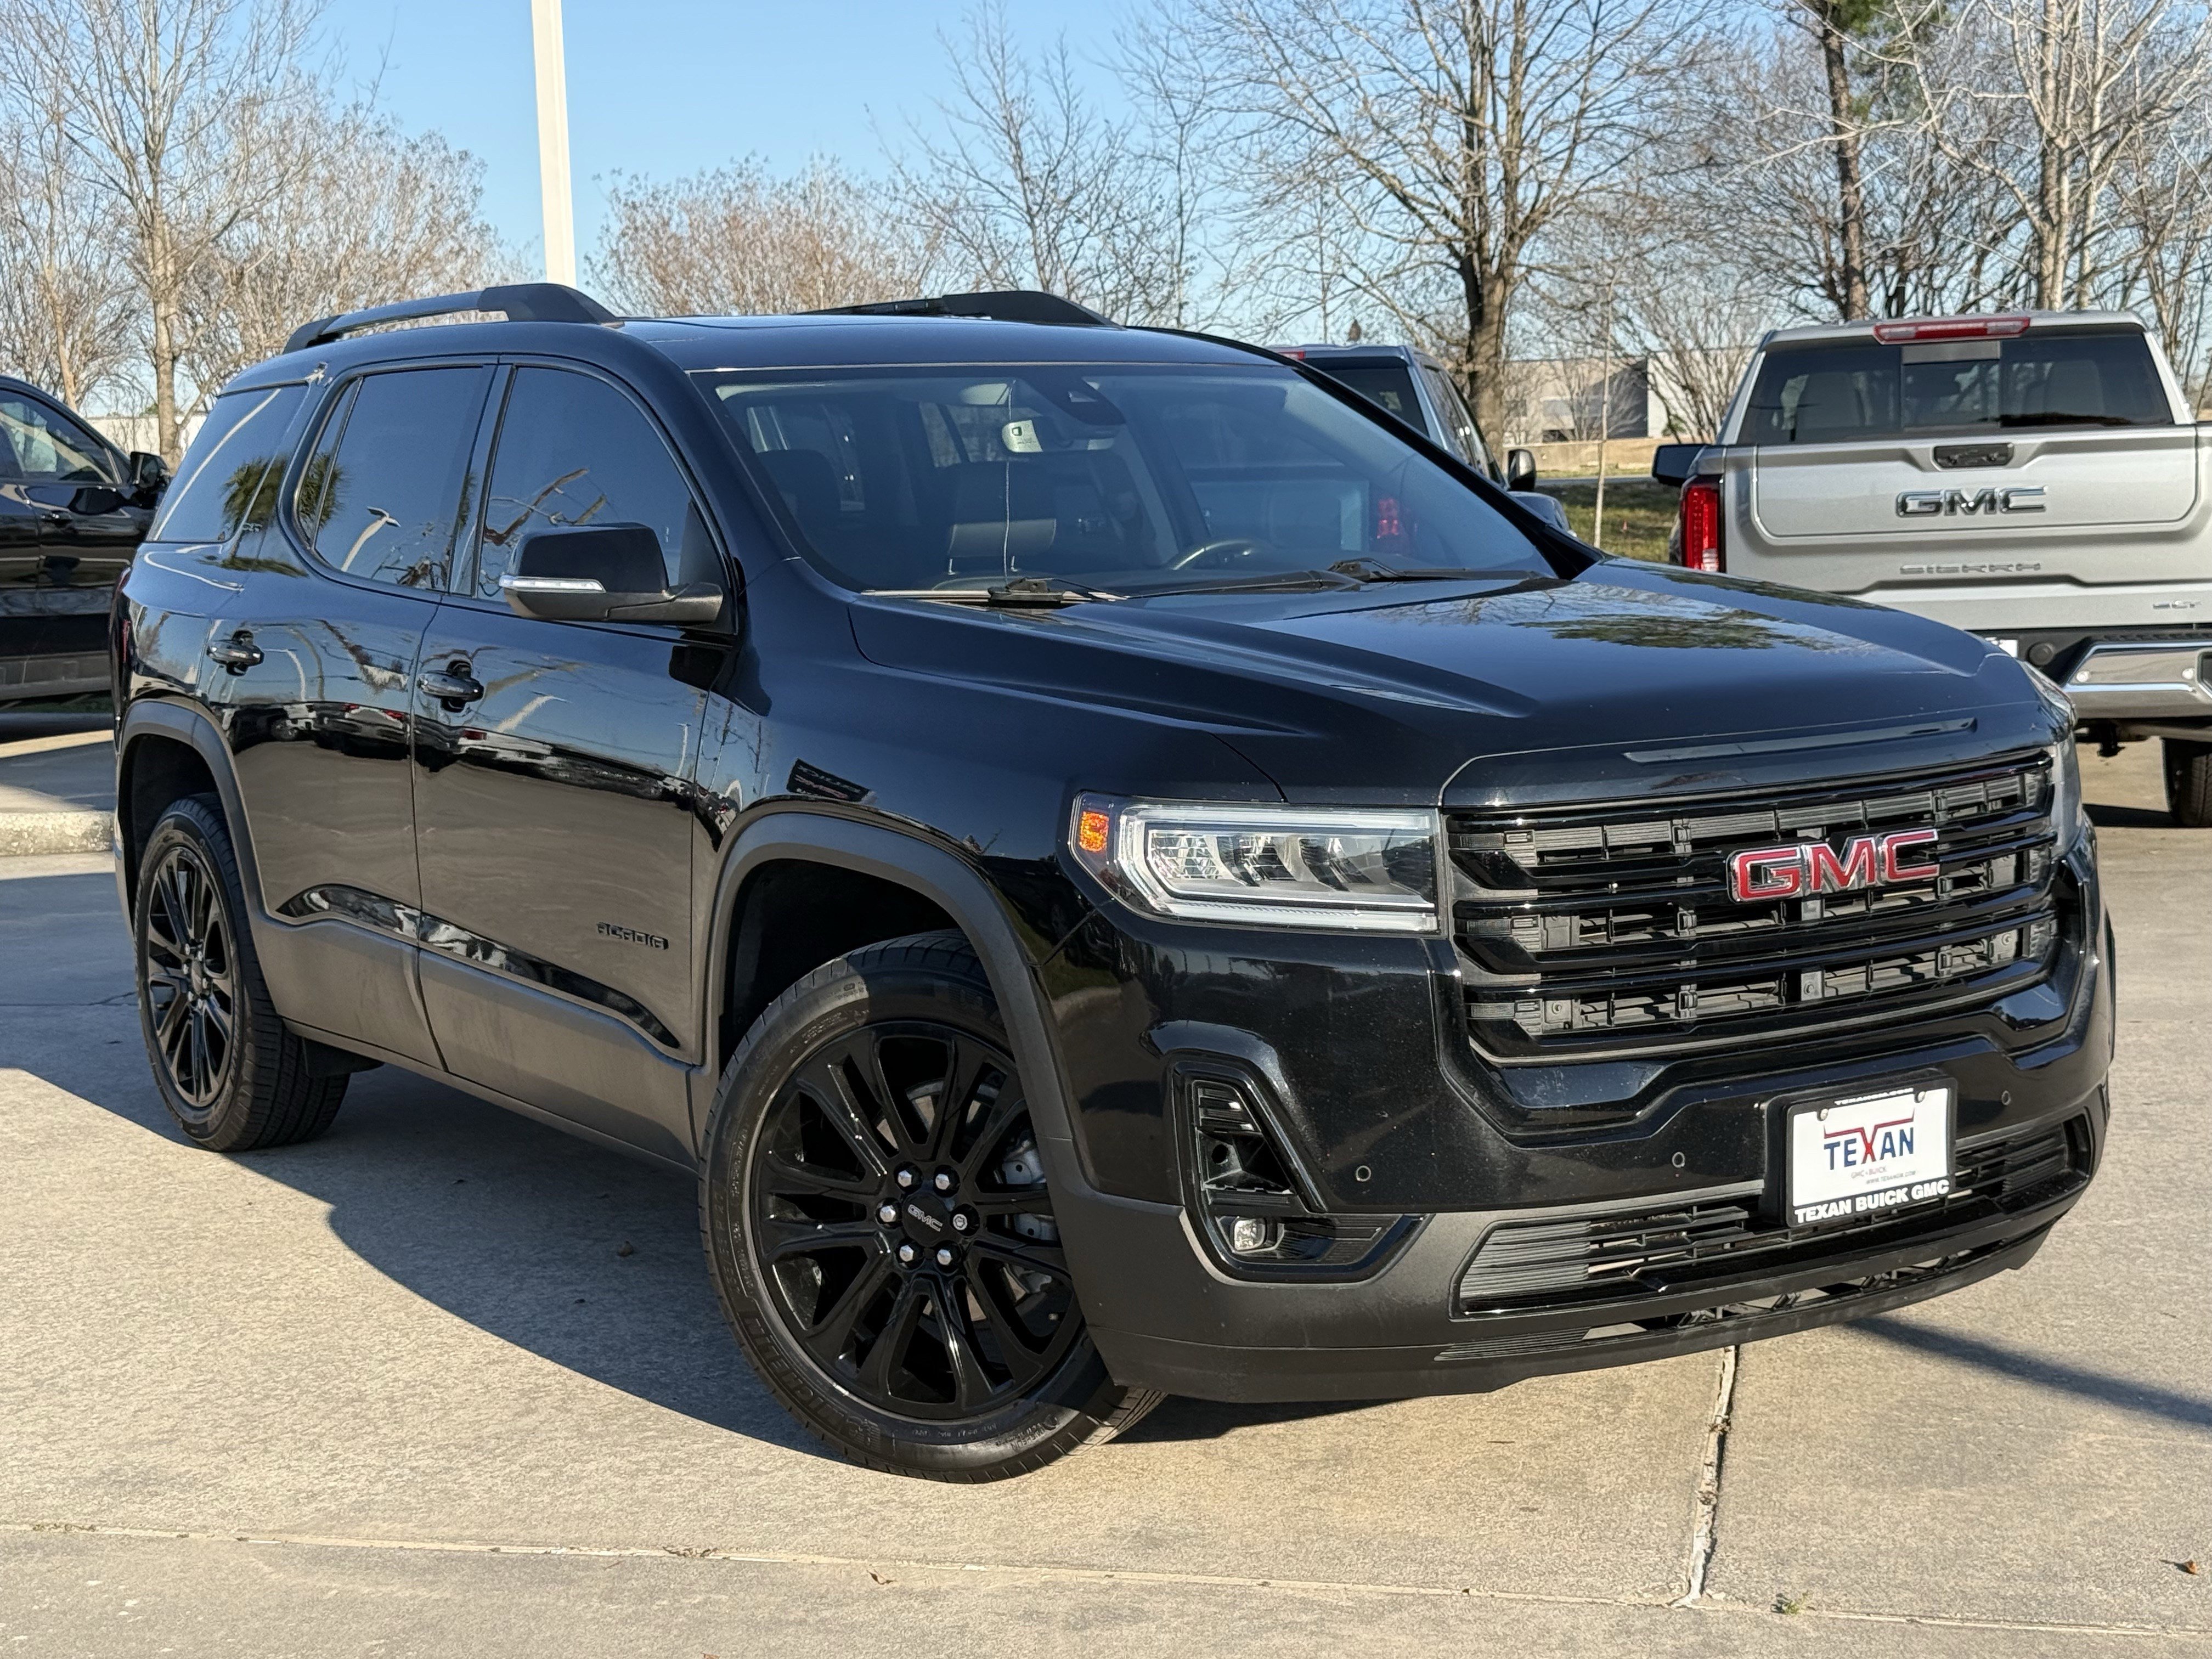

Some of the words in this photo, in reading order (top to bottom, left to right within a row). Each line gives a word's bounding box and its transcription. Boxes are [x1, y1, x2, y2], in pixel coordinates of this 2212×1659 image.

[1896, 487, 2047, 517] GMC
[1899, 563, 2040, 574] SIERRA
[1726, 828, 1940, 904] GMC
[1824, 1118, 1914, 1170] TEXAN
[908, 1204, 943, 1232] GMC
[1795, 1199, 1852, 1223] TEXAN
[1855, 1188, 1909, 1212] BUICK
[1911, 1180, 1949, 1200] GMC
[744, 1314, 845, 1426] MICHELIN
